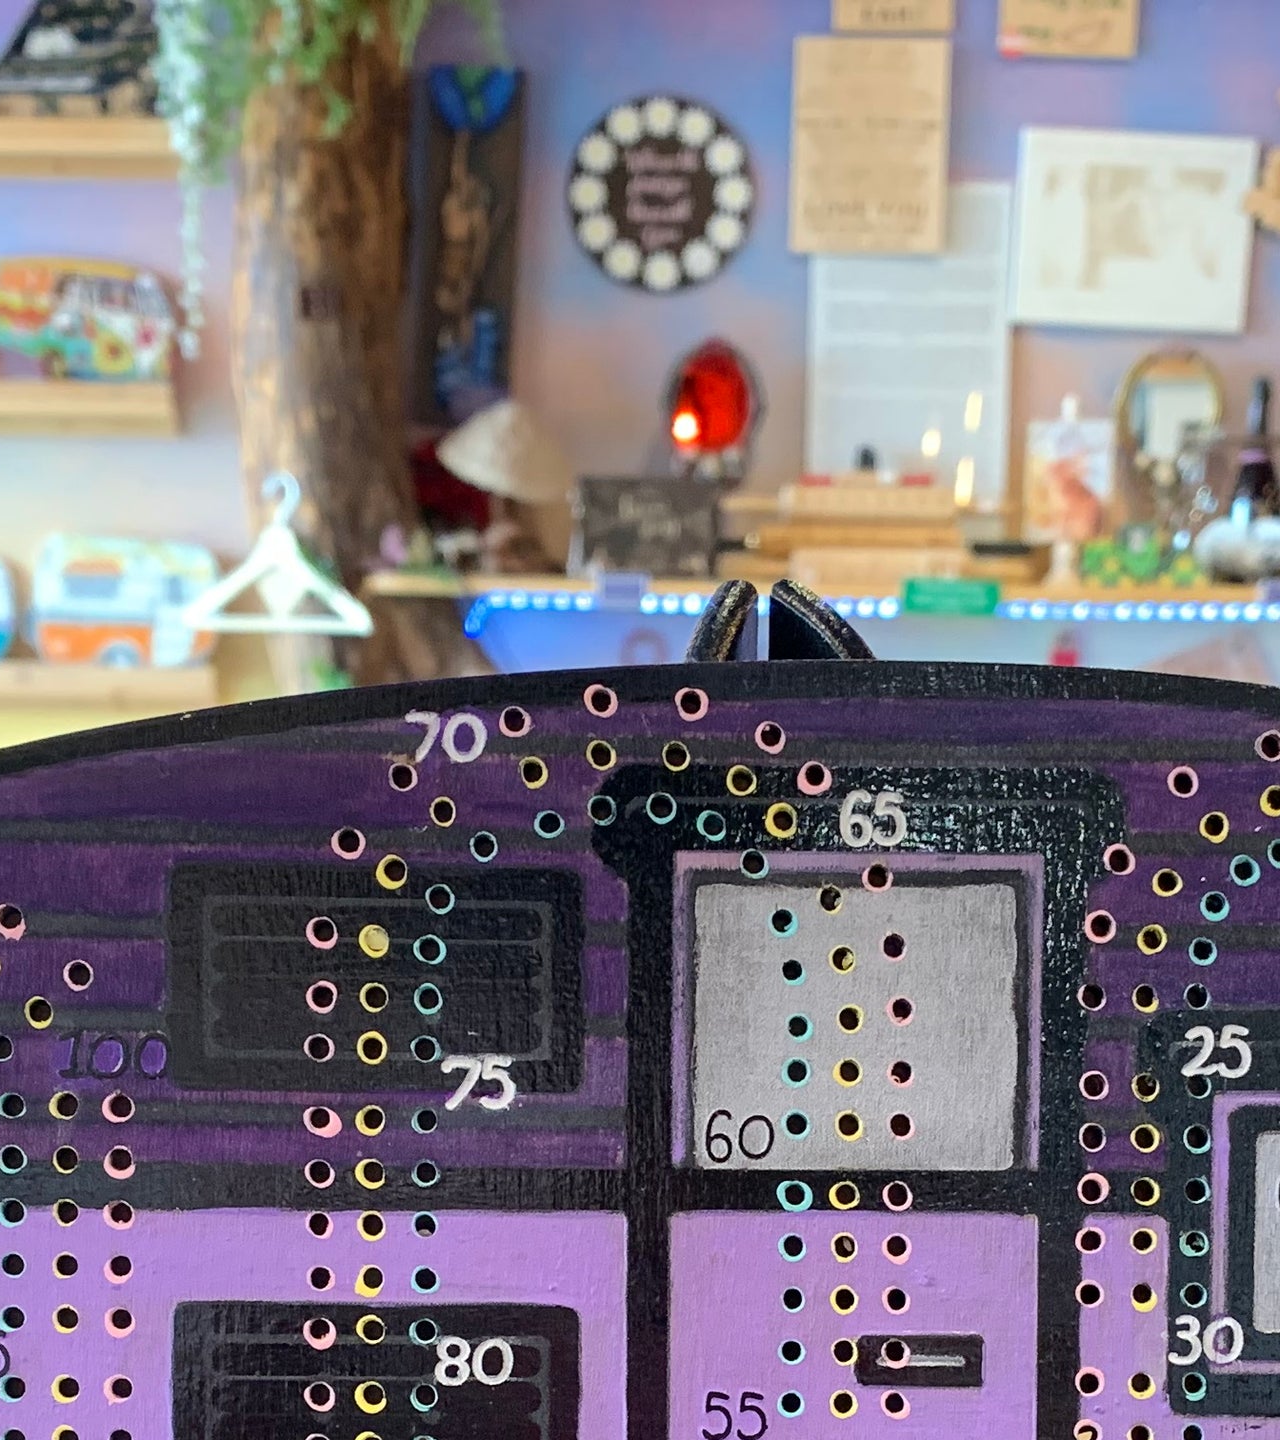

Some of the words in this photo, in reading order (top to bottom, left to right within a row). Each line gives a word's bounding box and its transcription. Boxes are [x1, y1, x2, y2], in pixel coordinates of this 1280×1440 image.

[404, 710, 487, 764] 70
[838, 790, 906, 847] 65
[59, 1032, 168, 1079] 100
[1180, 1024, 1253, 1078] 25
[441, 1055, 517, 1111] 75
[704, 1108, 775, 1162] 60
[434, 1336, 514, 1386] 80
[1168, 1317, 1245, 1366] 30
